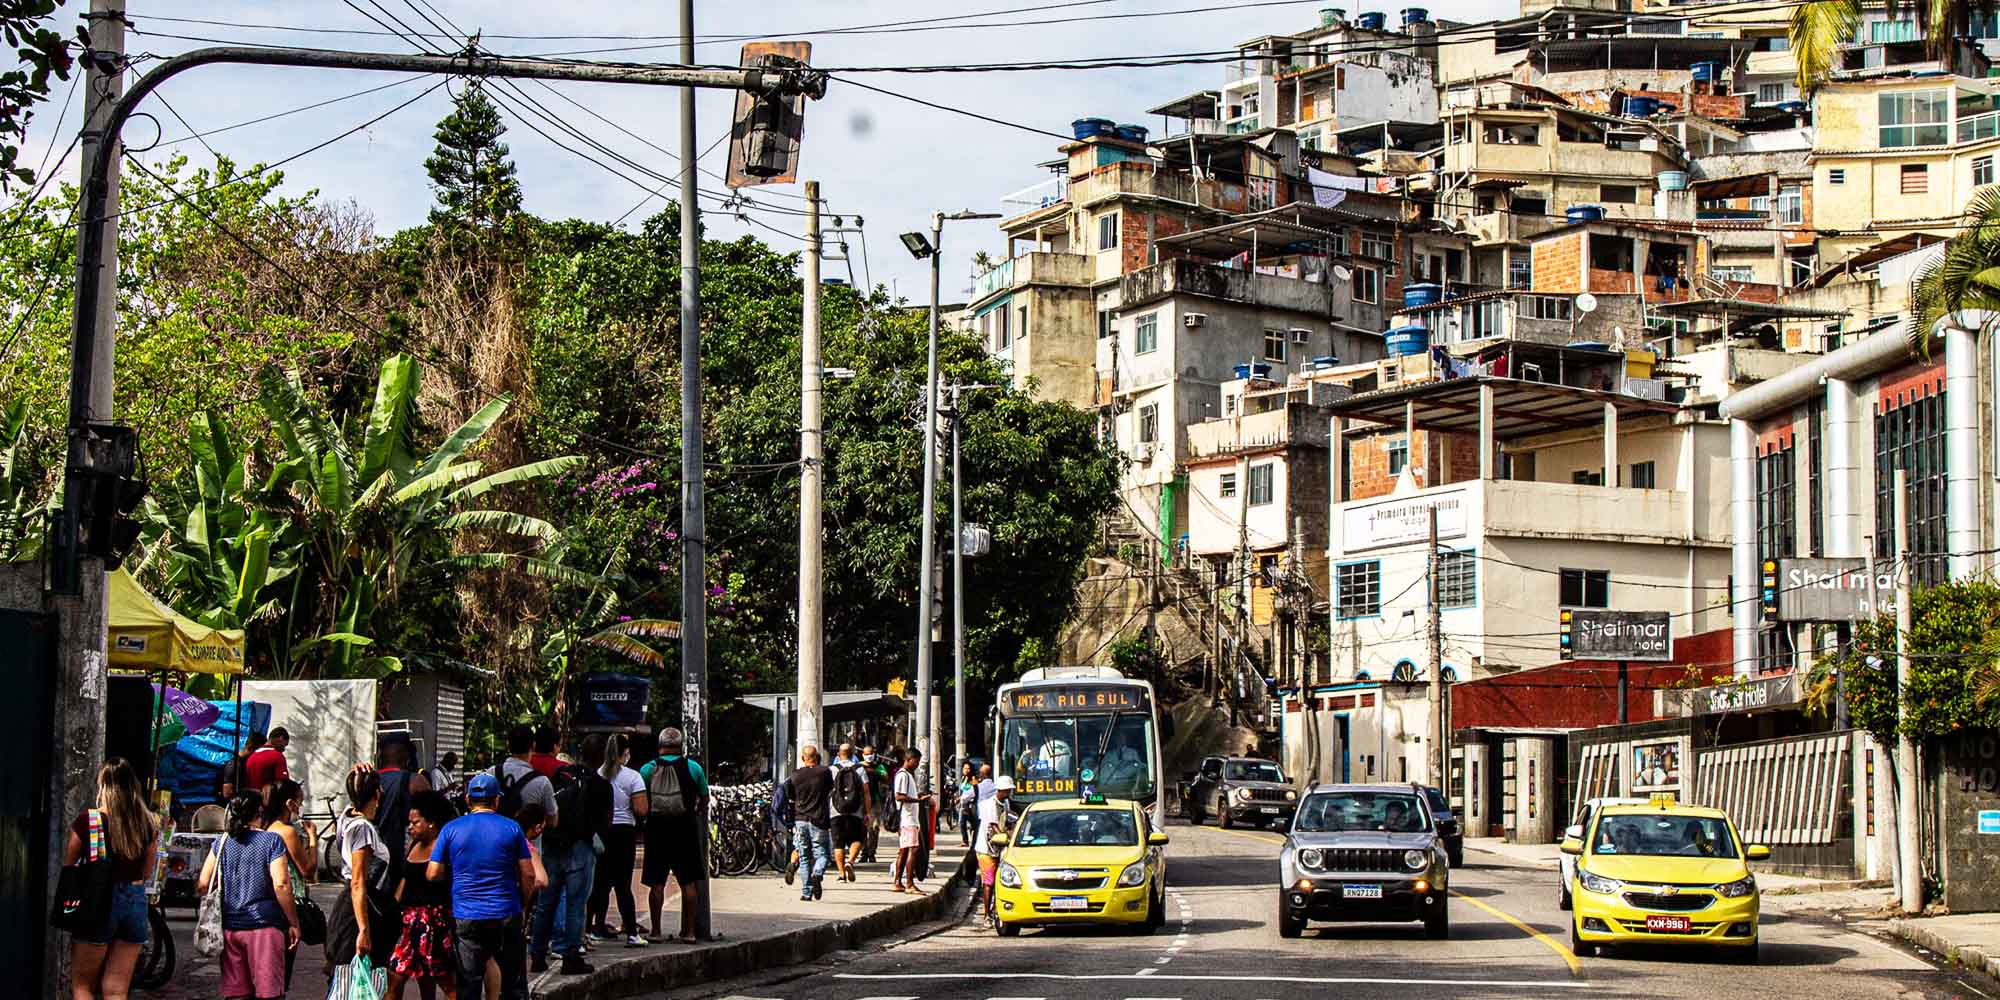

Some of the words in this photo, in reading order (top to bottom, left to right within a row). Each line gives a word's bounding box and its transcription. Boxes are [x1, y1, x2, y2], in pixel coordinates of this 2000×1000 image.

[1377, 508, 1406, 520] Primeira
[1409, 503, 1430, 516] Igreja
[1859, 598, 1897, 613] hte
[1581, 620, 1666, 638] Shalimar
[1058, 694, 1086, 706] RIO
[1097, 693, 1128, 705] SUL
[1745, 681, 1767, 706] Hotel
[1016, 779, 1074, 793] LEBLON
